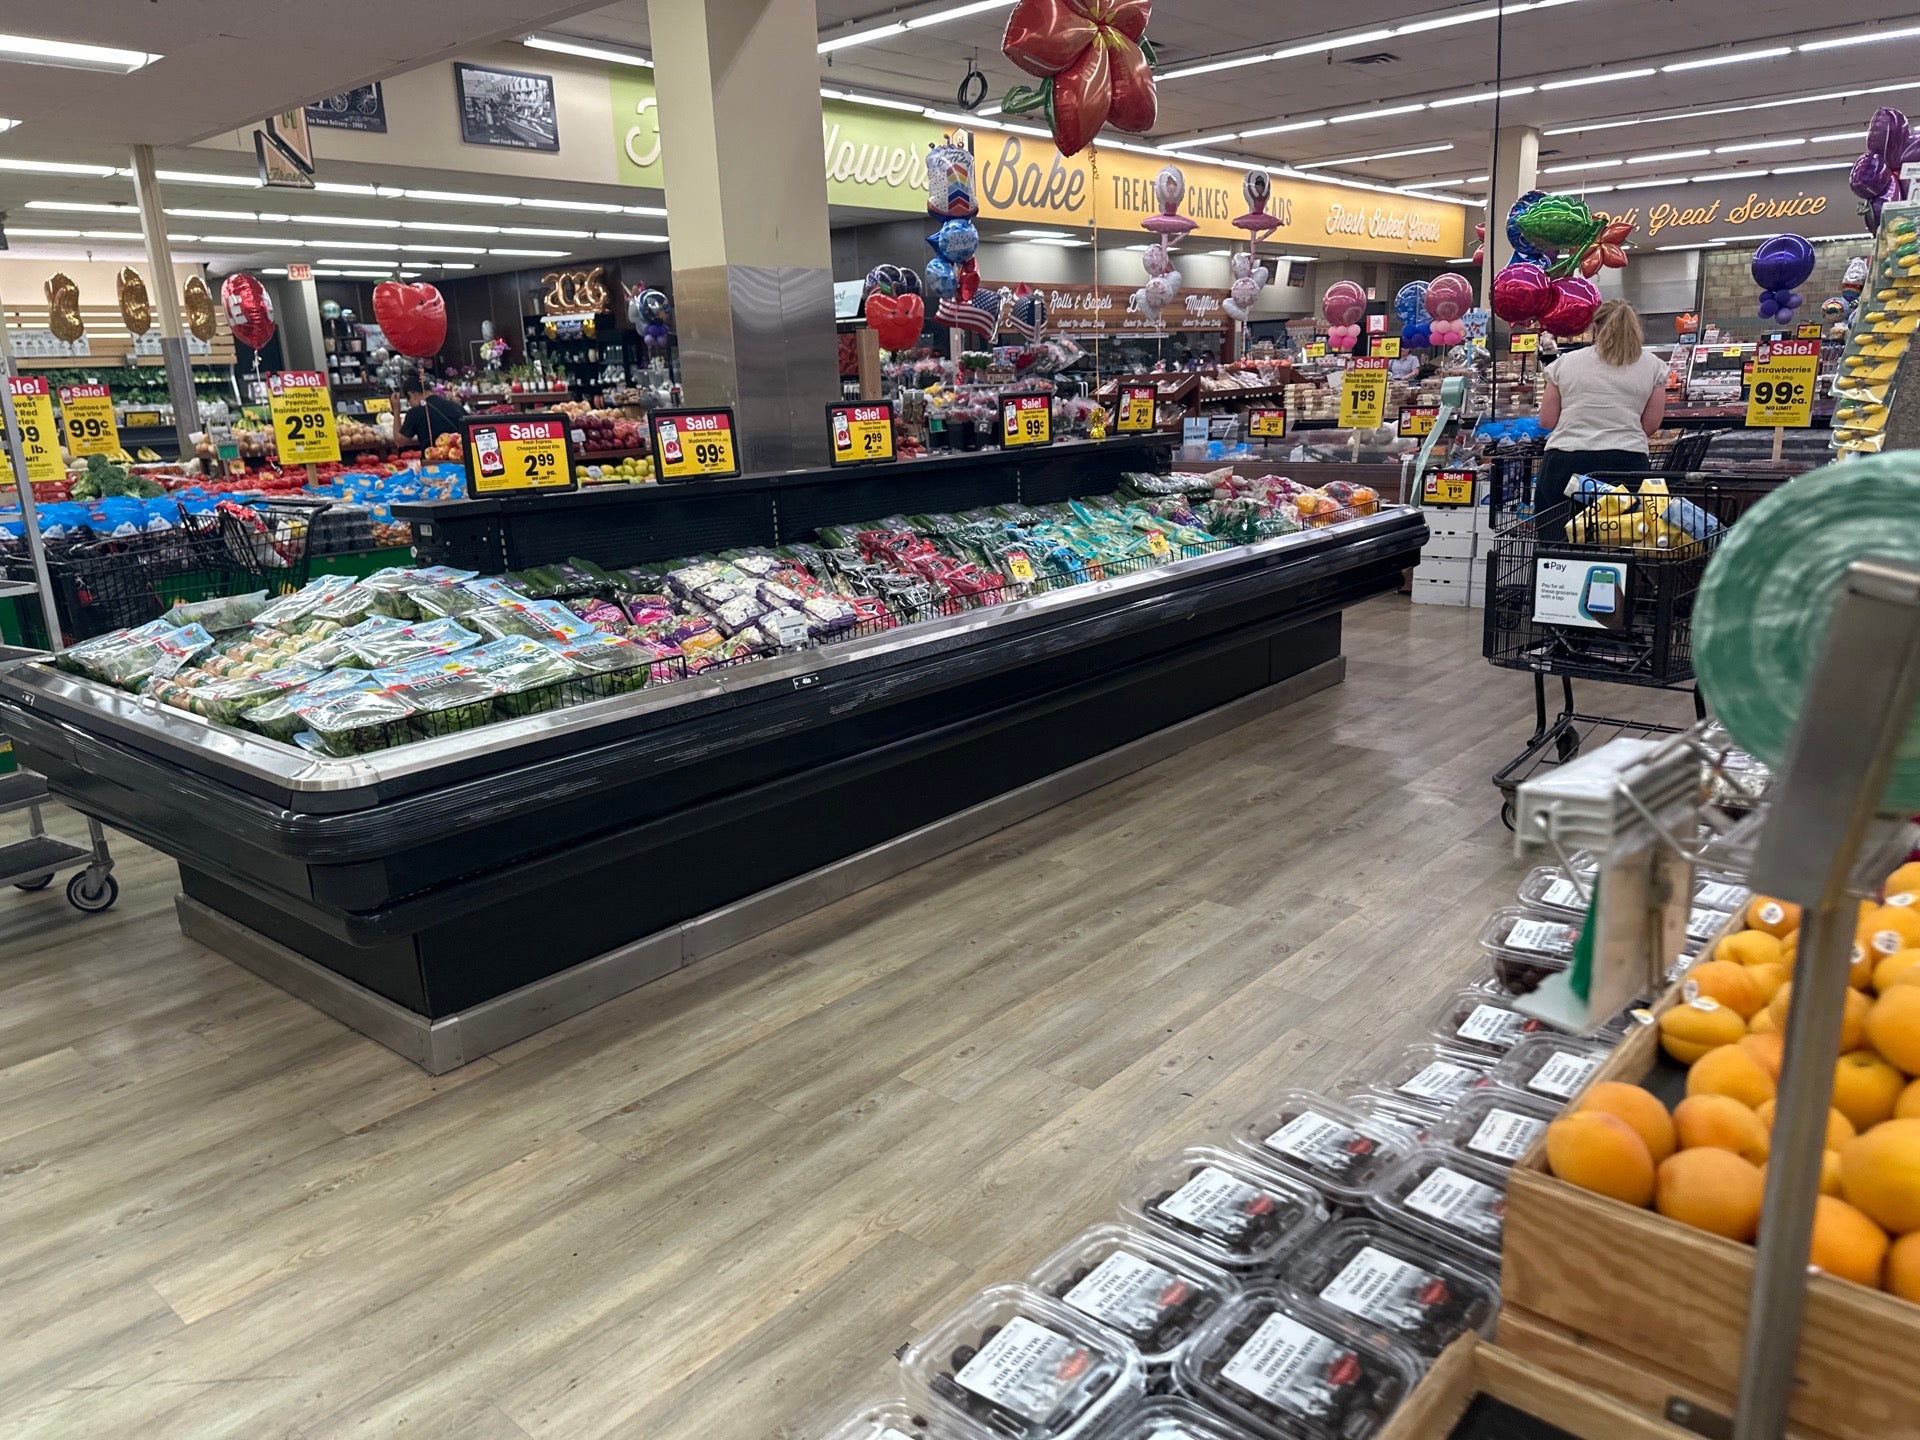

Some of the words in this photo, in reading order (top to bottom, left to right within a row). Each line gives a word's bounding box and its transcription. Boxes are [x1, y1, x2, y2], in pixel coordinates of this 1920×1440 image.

[824, 118, 928, 192] lowers
[982, 136, 1086, 212] Bake
[1188, 185, 1228, 220] CAKES
[1648, 199, 1720, 237] Great
[1724, 192, 1827, 224] Service
[1326, 204, 1366, 235] Fresh
[1368, 207, 1408, 240] Baked
[1408, 213, 1440, 249] Goods
[289, 264, 310, 279] EXIT
[1050, 290, 1072, 314] Rolls
[1185, 294, 1219, 318] Muffins
[1772, 342, 1812, 354] Sale!
[1356, 359, 1384, 368] Sale!
[9, 380, 40, 394] ale!
[284, 374, 320, 386] Sale!
[72, 387, 105, 397] Sale!
[1135, 388, 1150, 398] Sale!
[855, 408, 880, 420] Sale!
[1022, 398, 1041, 409] Sale!
[509, 424, 550, 439] Sale!
[686, 416, 718, 430] Sale!
[31, 446, 47, 454] lb.
[1550, 562, 1566, 572] Pay
[1300, 1126, 1340, 1153] CHOCOLATE
[1306, 1122, 1332, 1140] BRIDGE
[1291, 1140, 1307, 1151] MIX
[1205, 1184, 1231, 1203] MALTED
[1226, 1183, 1244, 1198] DARK
[1189, 1204, 1206, 1216] MILK
[1194, 1196, 1228, 1223] CHOCOLATE
[1114, 1268, 1142, 1292] MALTED
[1137, 1268, 1157, 1284] DARK
[1349, 1267, 1378, 1295] ALMONDS
[1391, 1265, 1409, 1282] DARK
[1360, 1272, 1388, 1299] COVERED
[1096, 1292, 1115, 1308] MILK
[1101, 1283, 1139, 1318] CHOCOLATE
[1360, 1281, 1394, 1315] CHOCOLATE
[994, 1345, 1018, 1368] BALLS
[1011, 1336, 1041, 1366] MALTED
[1035, 1335, 1057, 1357] DARK
[1253, 1337, 1285, 1372] ALMONDS
[1298, 1335, 1320, 1357] DARK
[1264, 1344, 1296, 1378] COVERED
[990, 1368, 1013, 1388] MILK
[993, 1355, 1038, 1398] CHOCOLATE
[1263, 1355, 1302, 1396] CHOCOLATE
